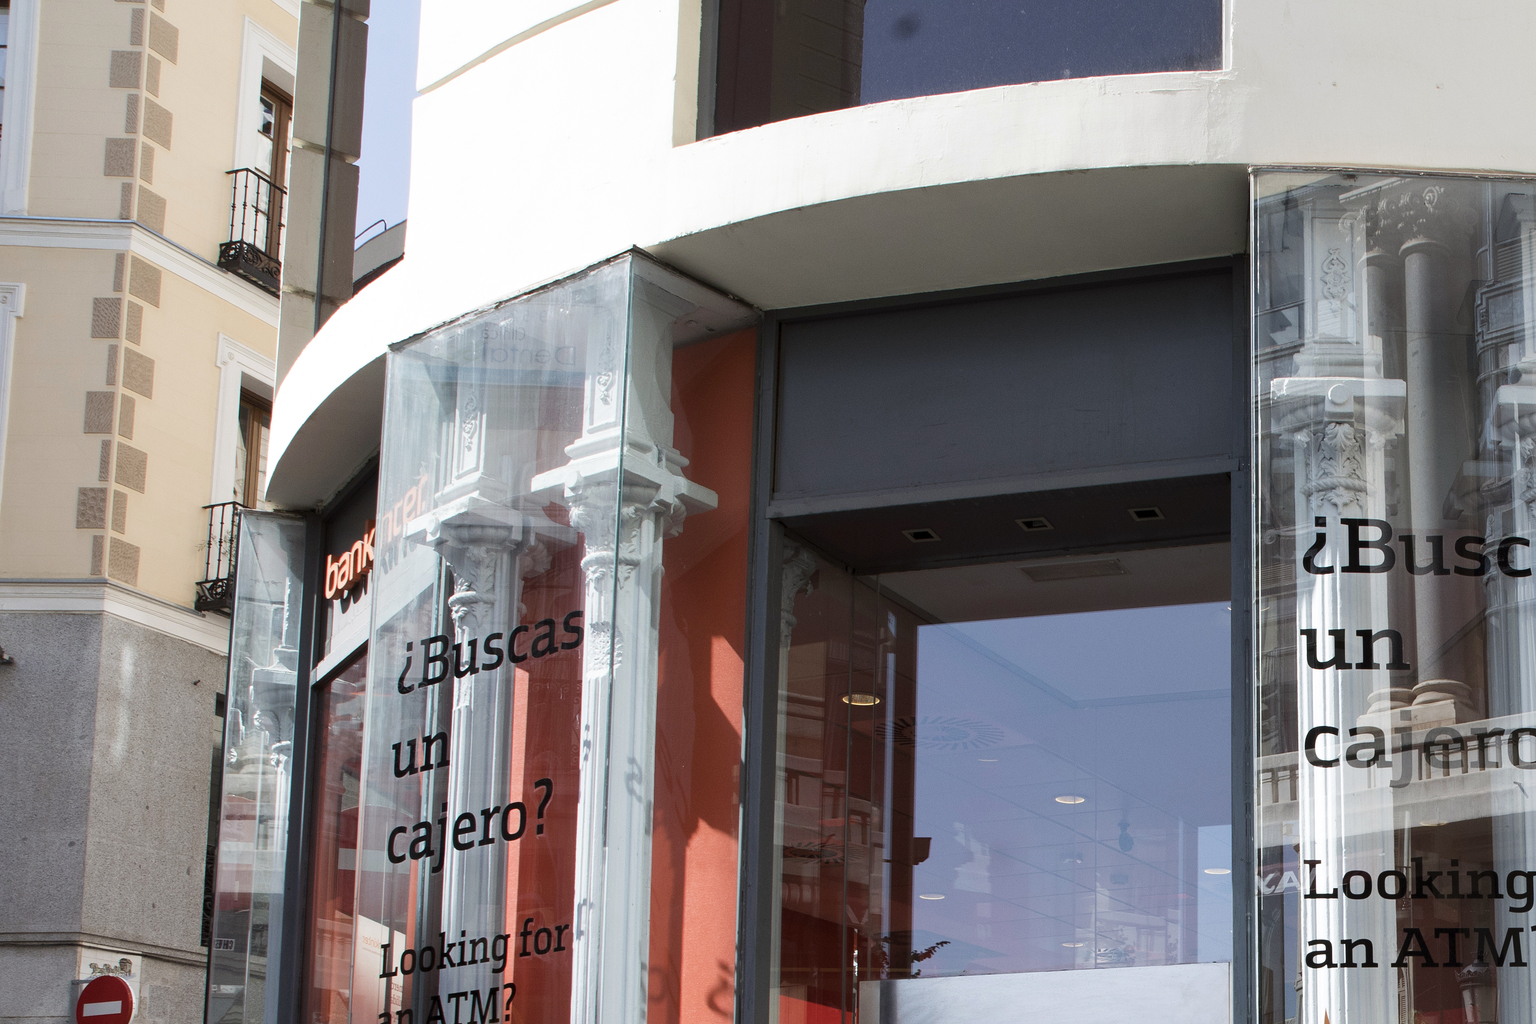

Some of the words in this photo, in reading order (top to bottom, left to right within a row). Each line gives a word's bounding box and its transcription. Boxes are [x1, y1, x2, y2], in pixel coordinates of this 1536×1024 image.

[397, 611, 585, 694] ¿Buscas
[1300, 627, 1411, 671] un
[391, 729, 450, 778] un
[387, 778, 553, 874] cajero?
[378, 930, 511, 978] Looking
[519, 917, 570, 958] for
[1305, 934, 1379, 969] an
